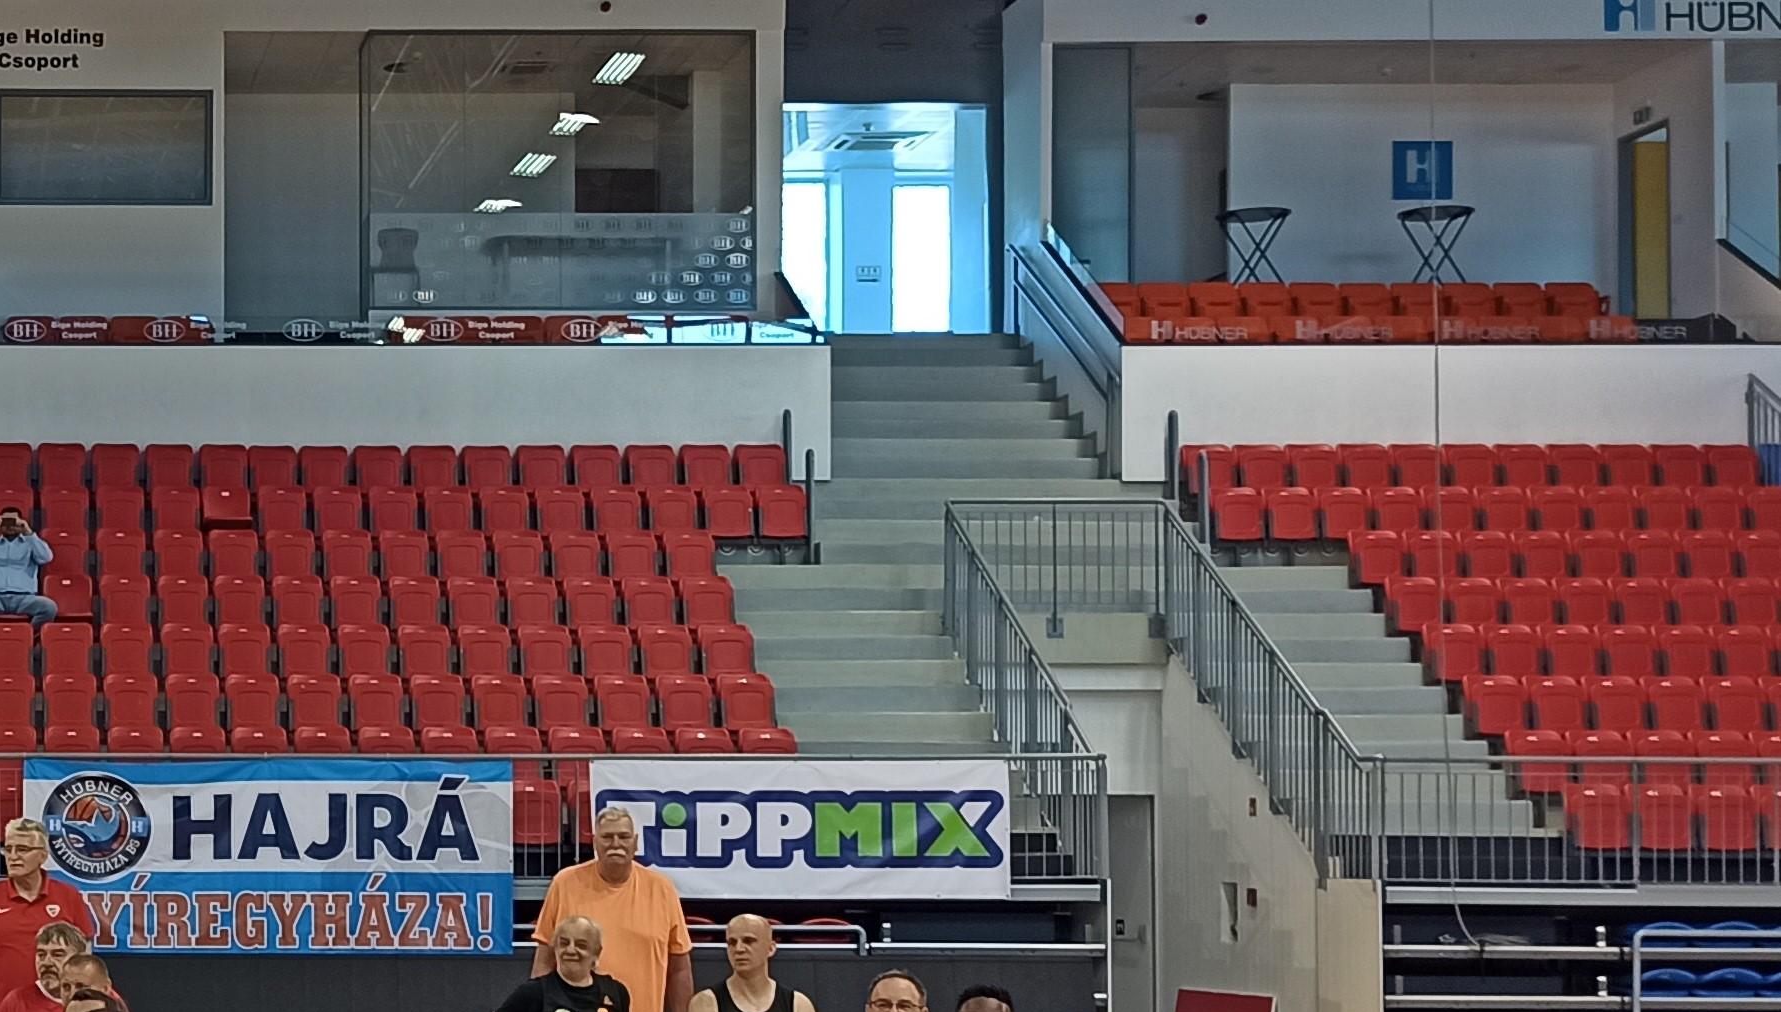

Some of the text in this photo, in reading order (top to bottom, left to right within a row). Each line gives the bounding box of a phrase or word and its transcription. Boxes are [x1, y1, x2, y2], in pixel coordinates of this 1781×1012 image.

[25, 28, 105, 47] Holding
[171, 775, 481, 862] HAJRÁ
[85, 874, 494, 952] YÍREGYHÁZA!
